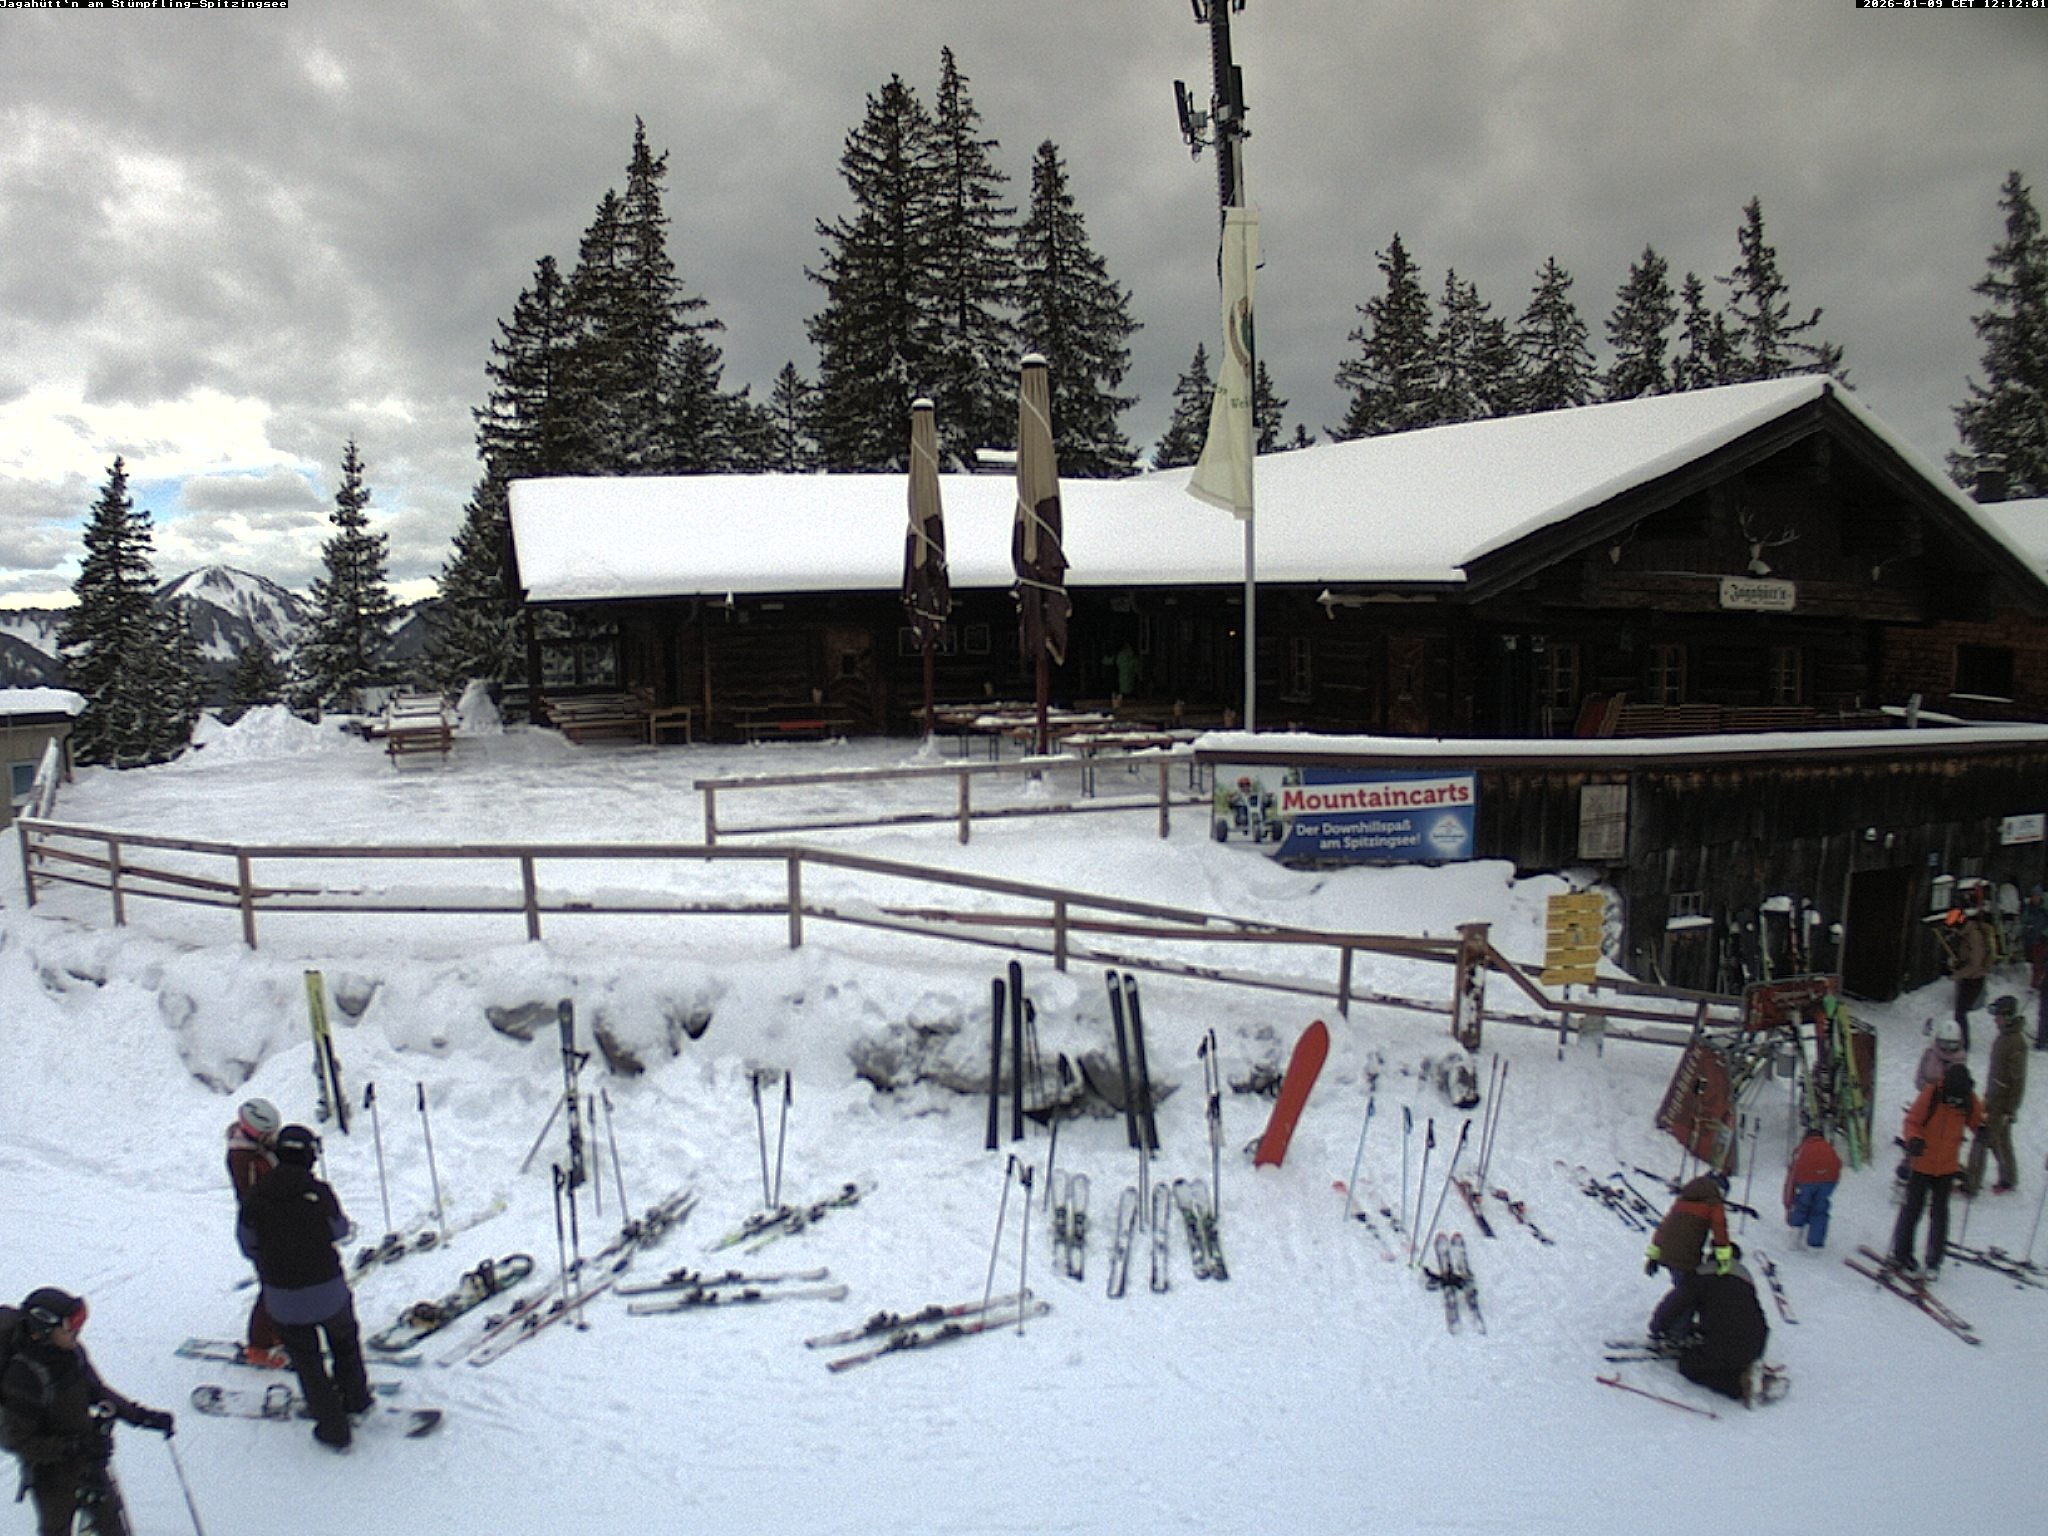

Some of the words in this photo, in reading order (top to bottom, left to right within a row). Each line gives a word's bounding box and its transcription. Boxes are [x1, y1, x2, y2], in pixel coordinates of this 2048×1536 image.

[1282, 783, 1470, 812] Mountaincarts
[1296, 824, 1319, 837] Der
[1322, 818, 1412, 837] Downhillspaß
[1319, 838, 1341, 850] am
